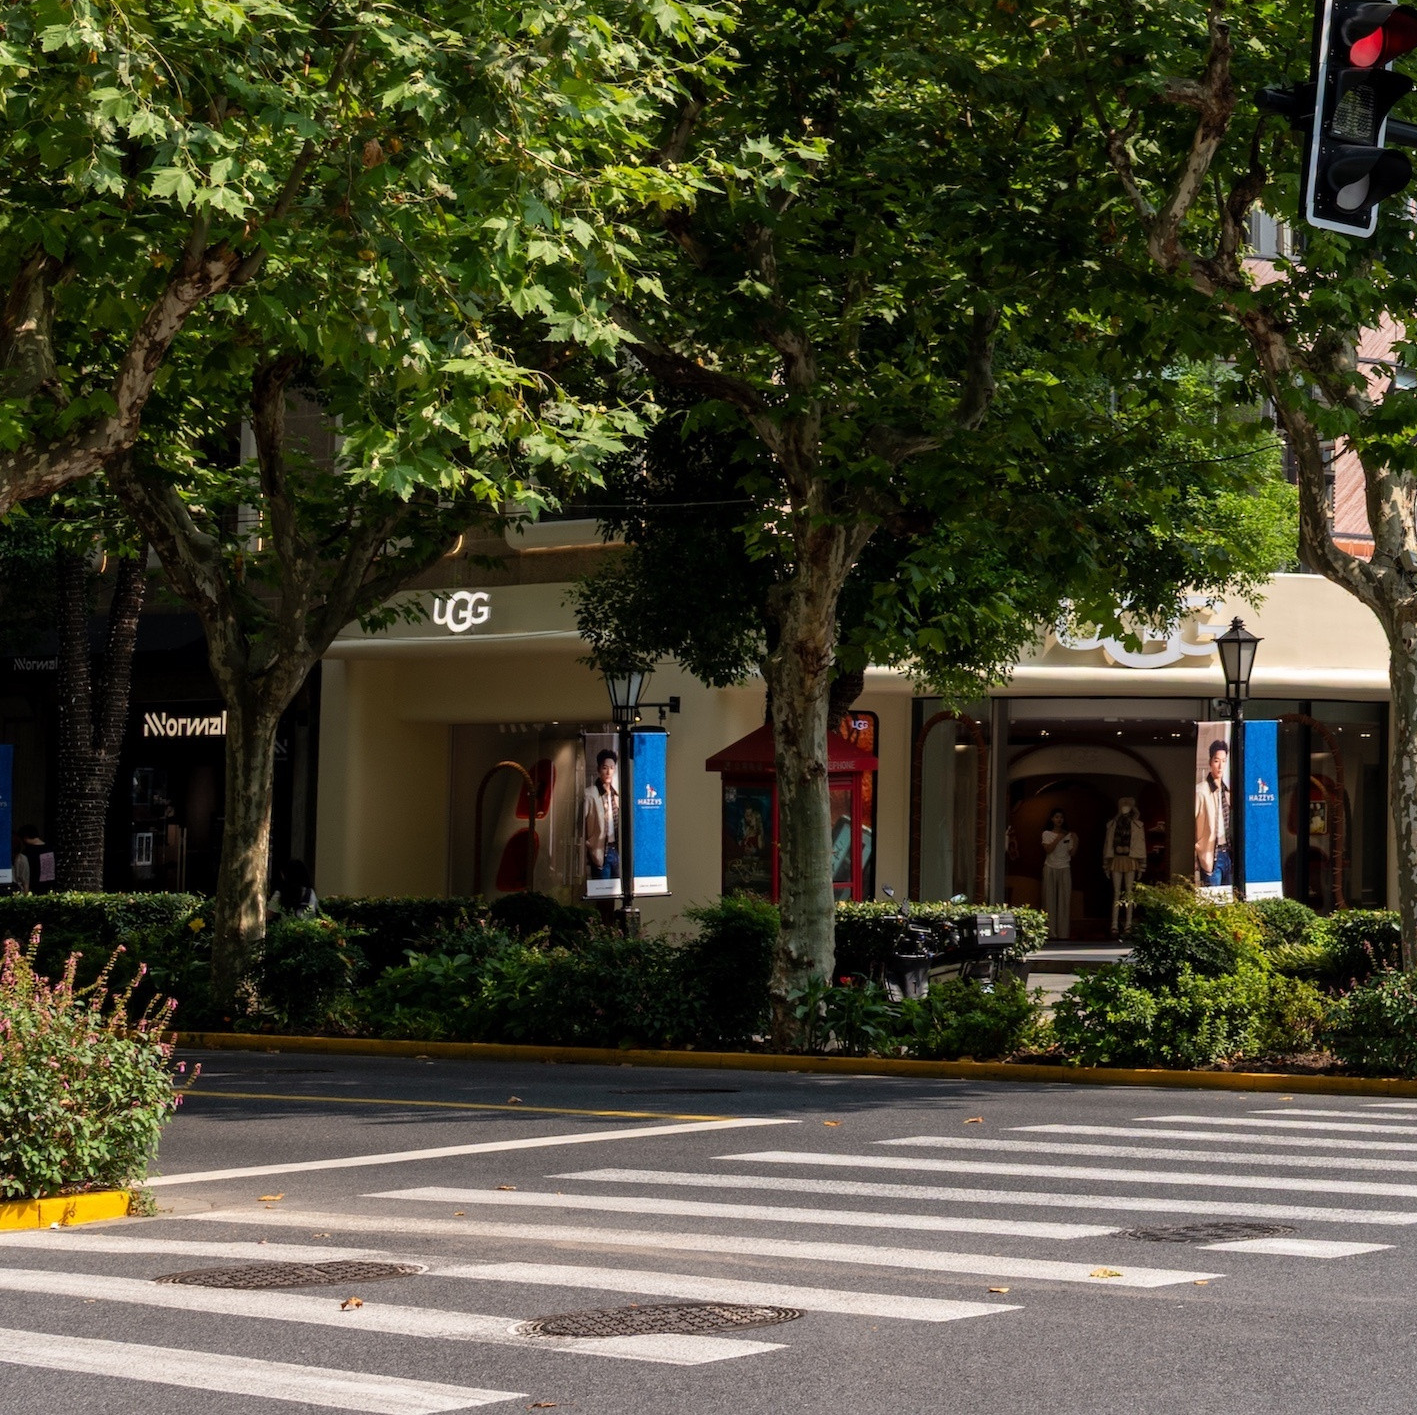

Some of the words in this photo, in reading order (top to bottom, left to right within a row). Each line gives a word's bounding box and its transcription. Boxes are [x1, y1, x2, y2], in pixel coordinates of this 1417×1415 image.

[432, 590, 492, 634] UGG
[850, 719, 870, 731] UGG
[637, 798, 663, 806] HAZZYS
[1248, 794, 1275, 802] HAZZYS
